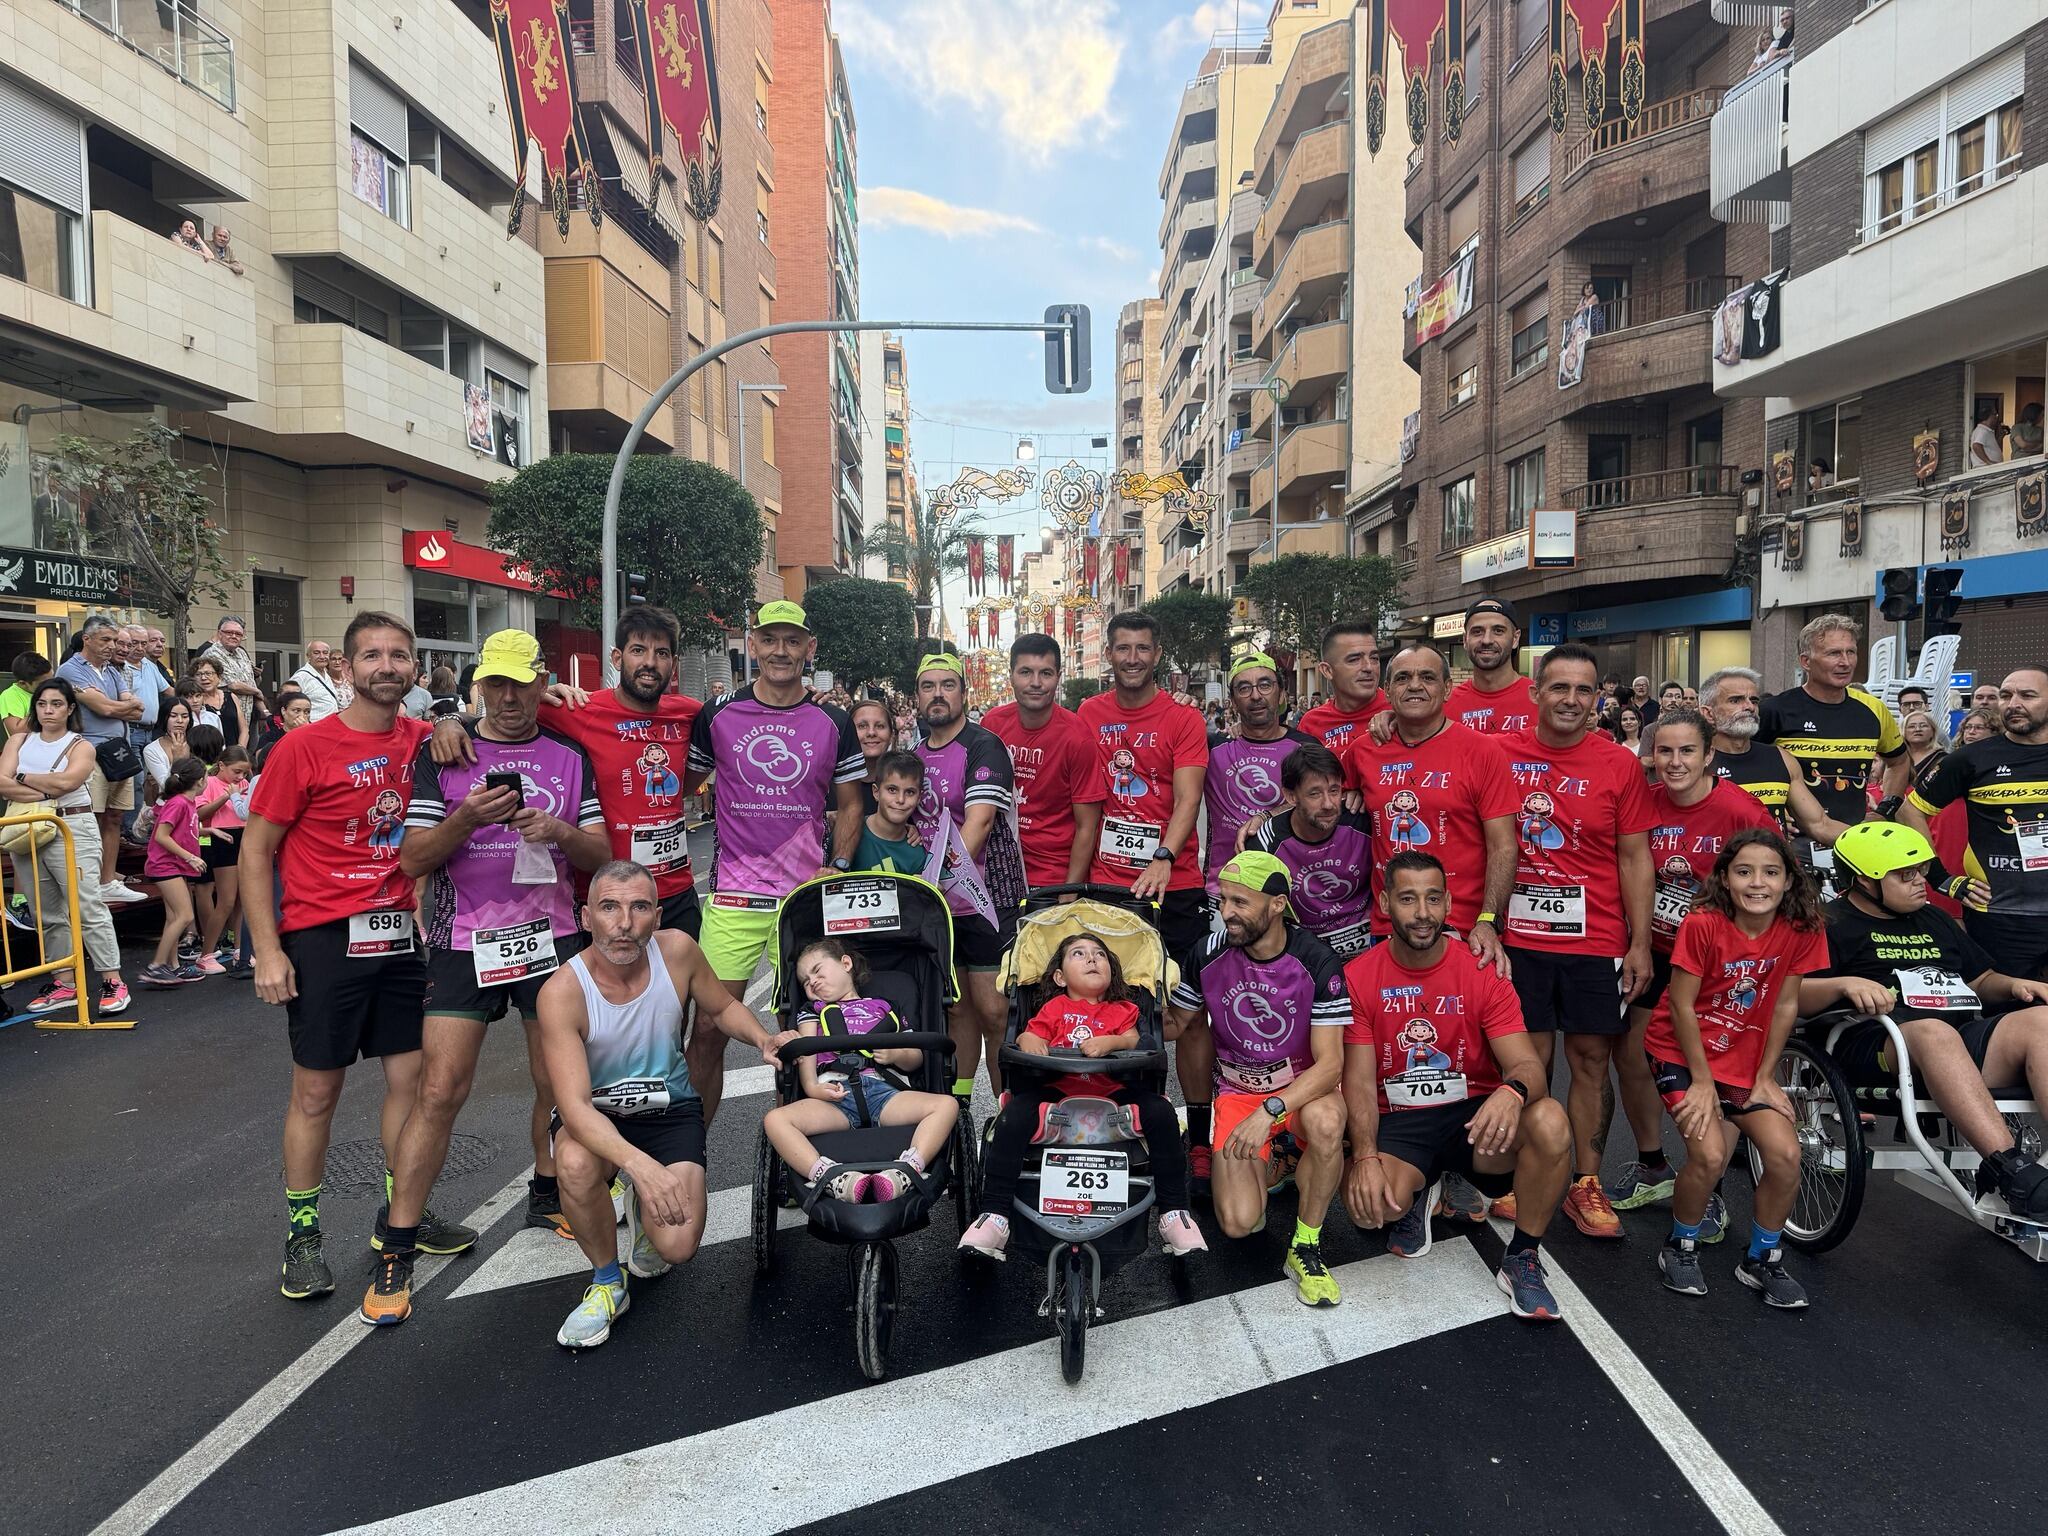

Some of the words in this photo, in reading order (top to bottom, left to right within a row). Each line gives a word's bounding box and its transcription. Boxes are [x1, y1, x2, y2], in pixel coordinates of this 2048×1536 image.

[34, 560, 118, 591] EMBLEMS
[50, 588, 74, 597] PRIDE
[1550, 620, 1560, 633] S
[1576, 616, 1607, 633] Sabadell
[1538, 634, 1560, 643] ATM
[1473, 709, 1493, 718] RETO
[630, 720, 652, 729] RETO
[1109, 724, 1127, 732] RETO
[1334, 724, 1353, 735] RETO
[1479, 716, 1487, 730] H
[1100, 733, 1111, 746] 24
[1115, 731, 1122, 745] H
[1325, 737, 1338, 749] 24
[1340, 732, 1349, 746] H
[801, 740, 814, 757] de
[1831, 745, 1861, 753] SOBRE
[348, 766, 362, 774] EL
[362, 757, 388, 770] RETO
[1392, 762, 1413, 771] RETO
[351, 771, 371, 788] 24
[374, 766, 385, 785] H
[551, 776, 565, 792] de
[1379, 773, 1393, 786] 24
[1397, 770, 1406, 785] H
[1530, 771, 1541, 786] H
[1556, 777, 1589, 797] ZOE
[756, 784, 788, 796] Rett
[730, 802, 774, 810] Asociación
[1663, 827, 1684, 835] RETO
[468, 842, 520, 850] Asociació
[653, 838, 680, 856] 265
[1116, 835, 1145, 850] 264
[1652, 836, 1664, 850] 24
[1669, 834, 1678, 851] H
[1693, 836, 1722, 854] ZOE
[1349, 864, 1360, 877] de
[1989, 857, 2022, 870] UPC
[845, 893, 882, 910] 733
[1528, 898, 1565, 914] 746
[1658, 896, 1690, 918] 576
[1320, 903, 1343, 918] Rett
[369, 914, 402, 931] 698
[1871, 932, 1934, 945] GIMNASIO
[500, 937, 539, 958] 526
[1876, 947, 1942, 960] ESPADAS
[504, 956, 534, 967] MANUEL
[1724, 969, 1738, 978] 24
[1382, 989, 1395, 997] EL
[1396, 986, 1421, 996] RETO
[1284, 999, 1298, 1015] de
[1383, 997, 1401, 1013] 24
[1405, 996, 1416, 1013] H
[1435, 995, 1465, 1015] ZOE
[1243, 1040, 1275, 1052] Rett
[1239, 1074, 1273, 1086] 631
[1407, 1082, 1447, 1097] 704
[1066, 1171, 1109, 1190] 263
